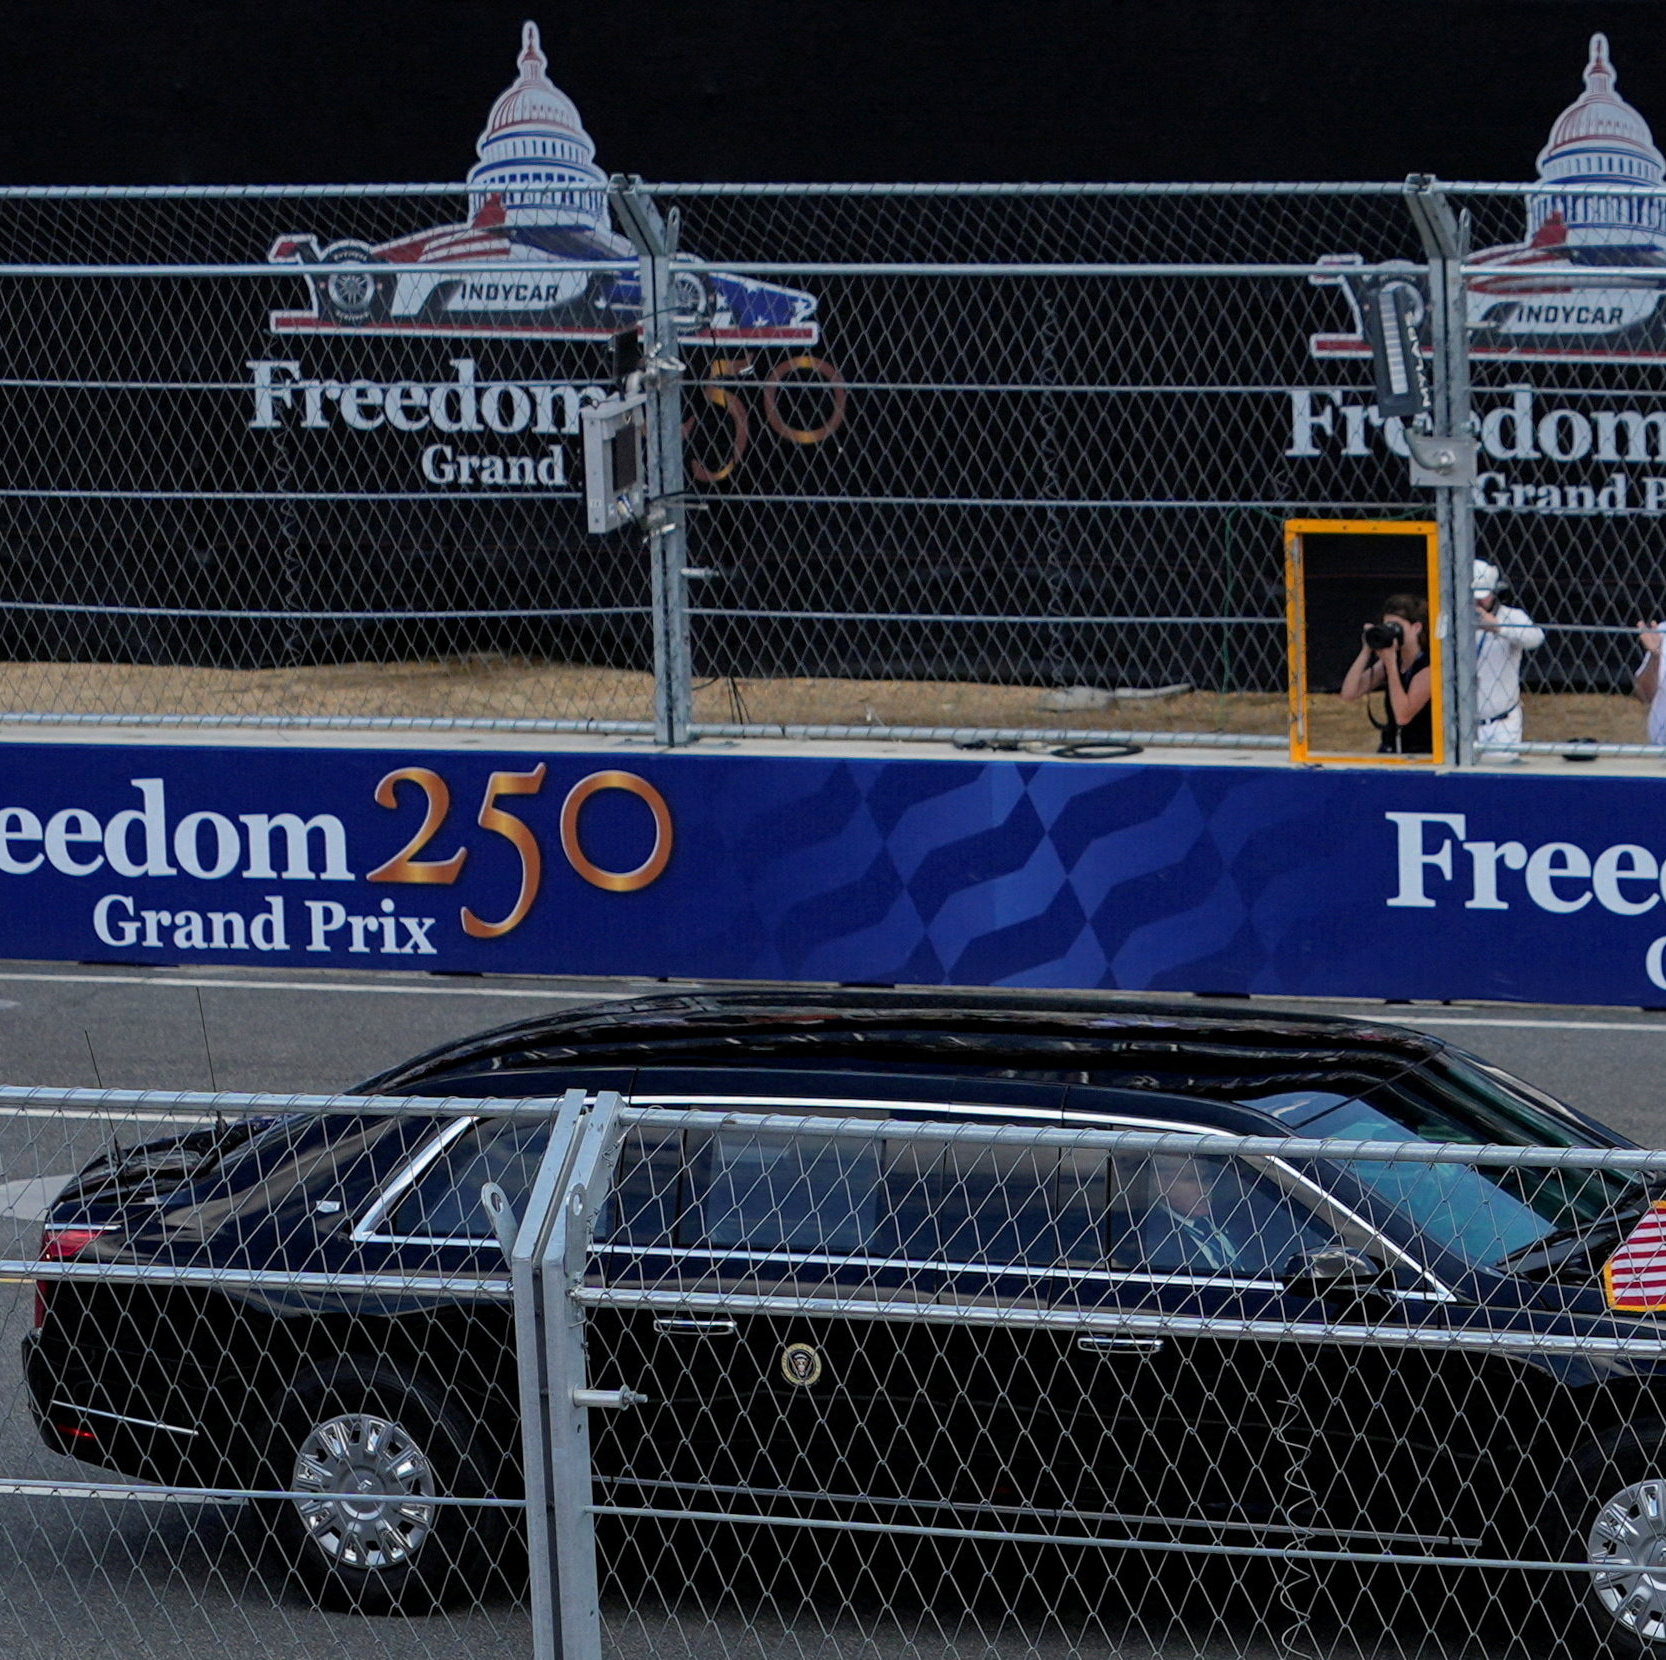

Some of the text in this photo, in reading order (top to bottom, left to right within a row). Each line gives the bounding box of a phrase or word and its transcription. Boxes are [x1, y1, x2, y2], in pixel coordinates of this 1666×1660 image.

[461, 283, 559, 302] INDYCAR
[1517, 305, 1624, 325] INDYCAR
[683, 352, 847, 483] 50
[421, 443, 568, 487] Grand
[1472, 472, 1627, 516] Grand
[366, 761, 675, 940] 250
[92, 893, 438, 956] Grand Prix
